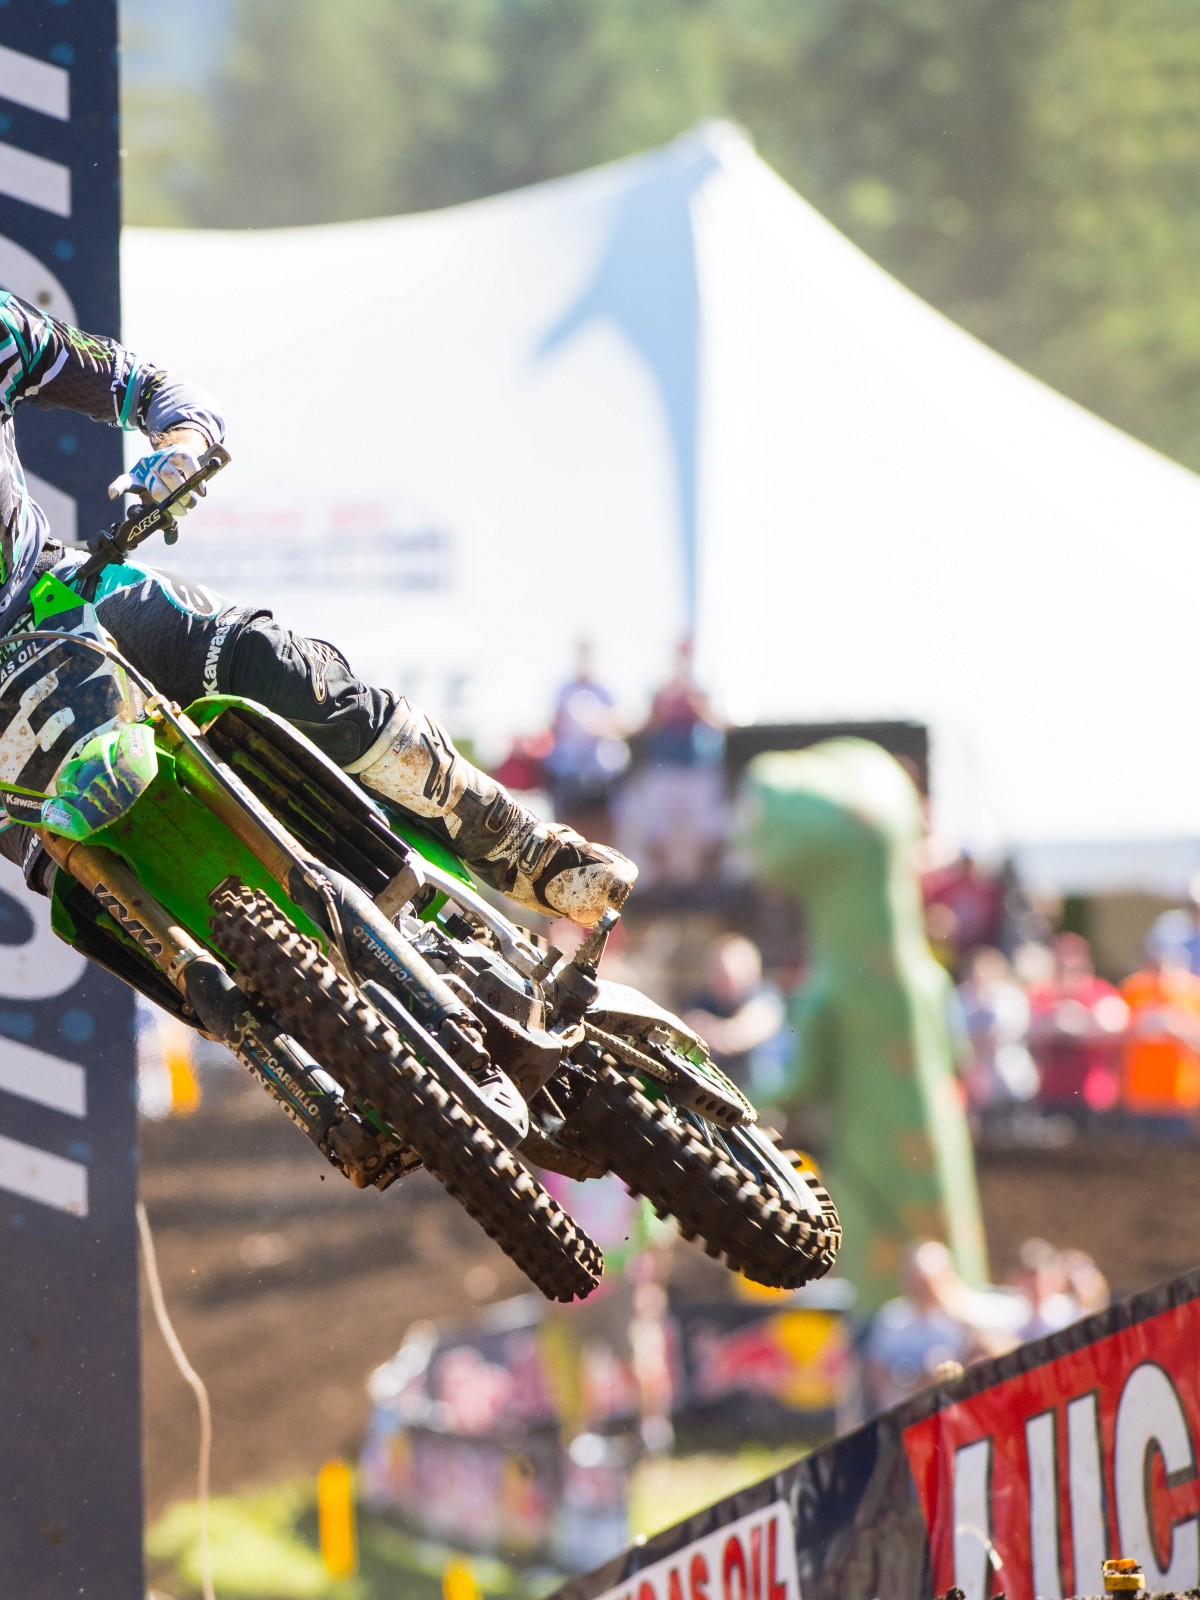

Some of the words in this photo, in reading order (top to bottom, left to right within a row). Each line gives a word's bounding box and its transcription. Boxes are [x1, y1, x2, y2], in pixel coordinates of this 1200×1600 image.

[127, 508, 162, 542] ARC
[18, 641, 42, 665] OIL
[6, 794, 45, 811] Kawasa
[268, 1056, 320, 1117] CARRILLO
